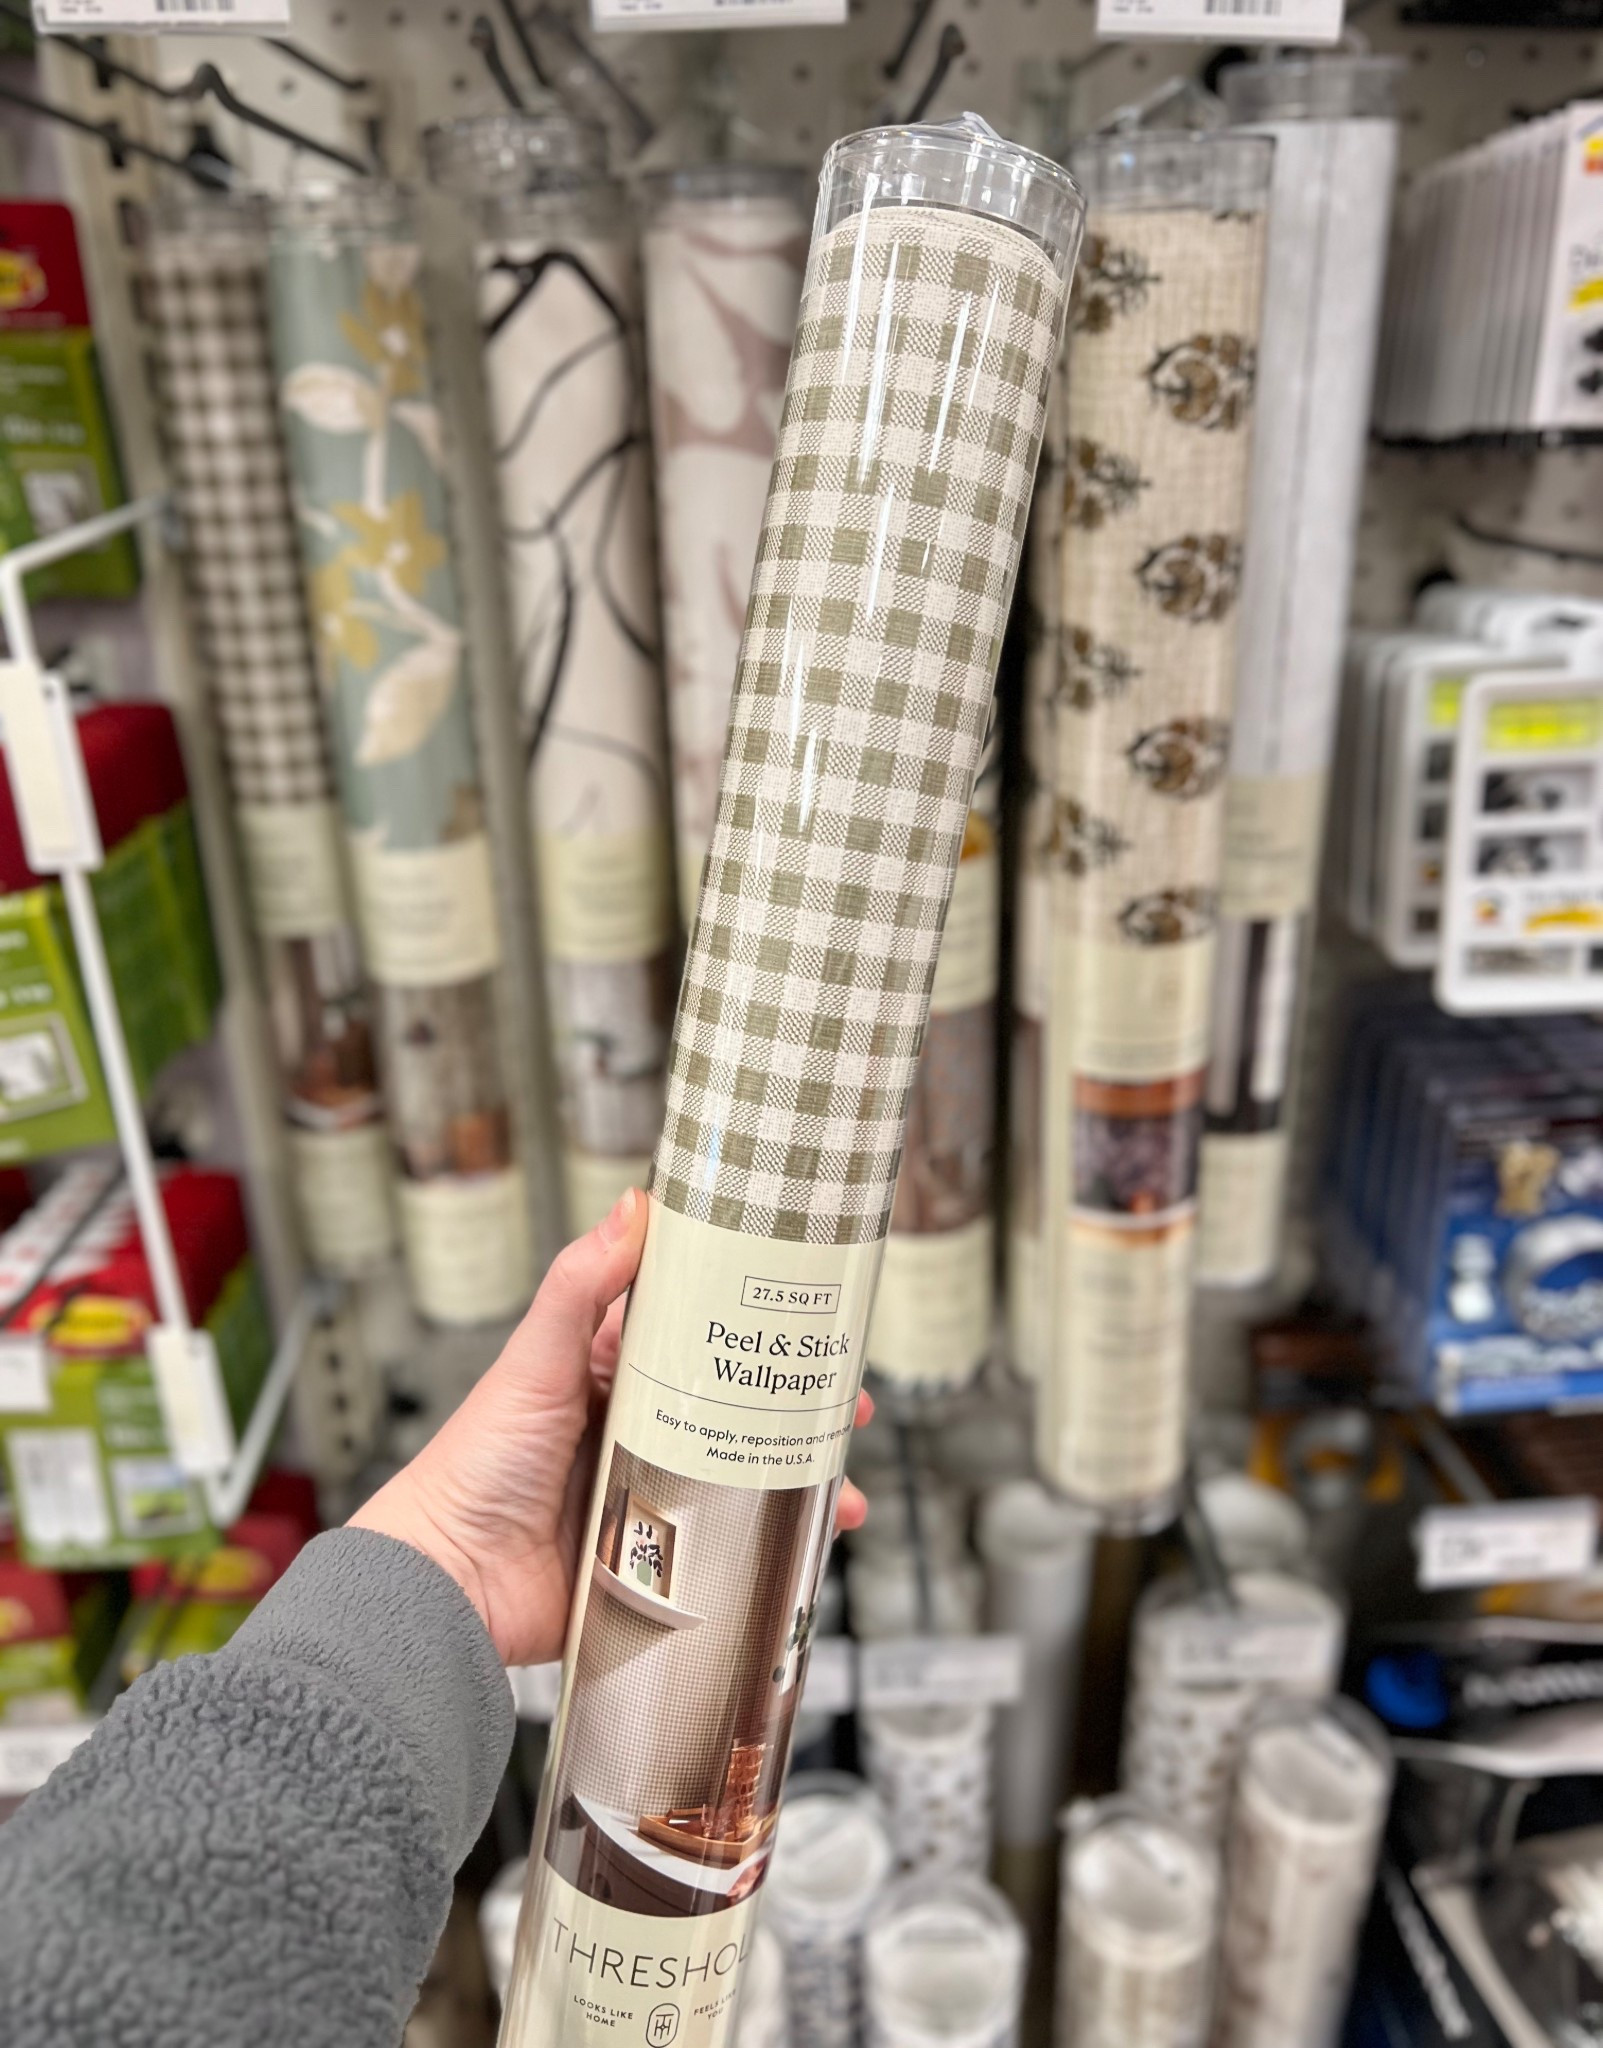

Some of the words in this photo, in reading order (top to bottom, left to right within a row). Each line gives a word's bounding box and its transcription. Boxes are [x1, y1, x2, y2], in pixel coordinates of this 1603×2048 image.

[753, 1287, 784, 1303] 27.5
[788, 1291, 809, 1306] SQ
[813, 1293, 833, 1305] FT
[705, 1321, 763, 1353] Peel
[769, 1333, 792, 1357] &
[797, 1332, 850, 1358] Stick
[713, 1356, 837, 1396] Wallpaper
[656, 1409, 681, 1430] Easy
[684, 1420, 697, 1433] to
[700, 1426, 738, 1445] apply,
[741, 1434, 803, 1447] reposition
[805, 1432, 825, 1445] and
[706, 1446, 745, 1463] Made
[748, 1453, 759, 1464] in
[762, 1454, 783, 1466] the
[785, 1453, 815, 1466] U.S.A.
[574, 1995, 606, 2014] LOOKS
[610, 2009, 633, 2020] LIKE
[693, 2000, 719, 2016] FEELS
[707, 2007, 724, 2020] YOU
[585, 2011, 616, 2027] HOME
